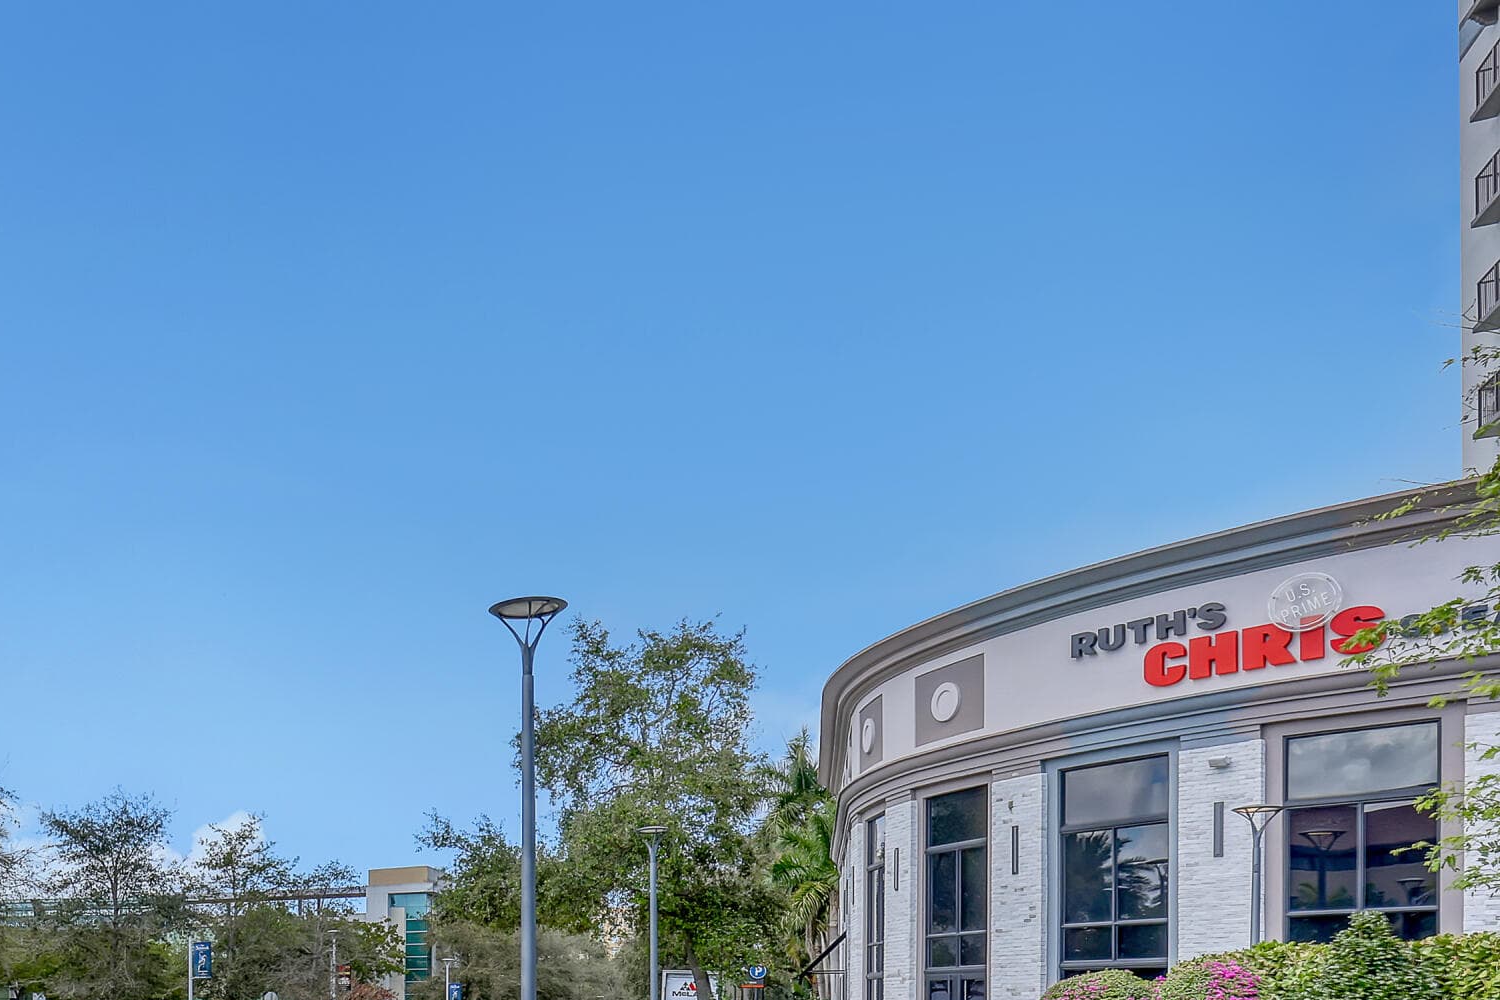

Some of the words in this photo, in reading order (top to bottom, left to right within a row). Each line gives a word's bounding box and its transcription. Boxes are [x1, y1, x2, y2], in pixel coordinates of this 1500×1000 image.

[1280, 591, 1333, 622] PRIME
[1284, 583, 1316, 602] U.S.
[1070, 602, 1227, 660] RUTH'S
[1143, 605, 1387, 688] CHRIS
